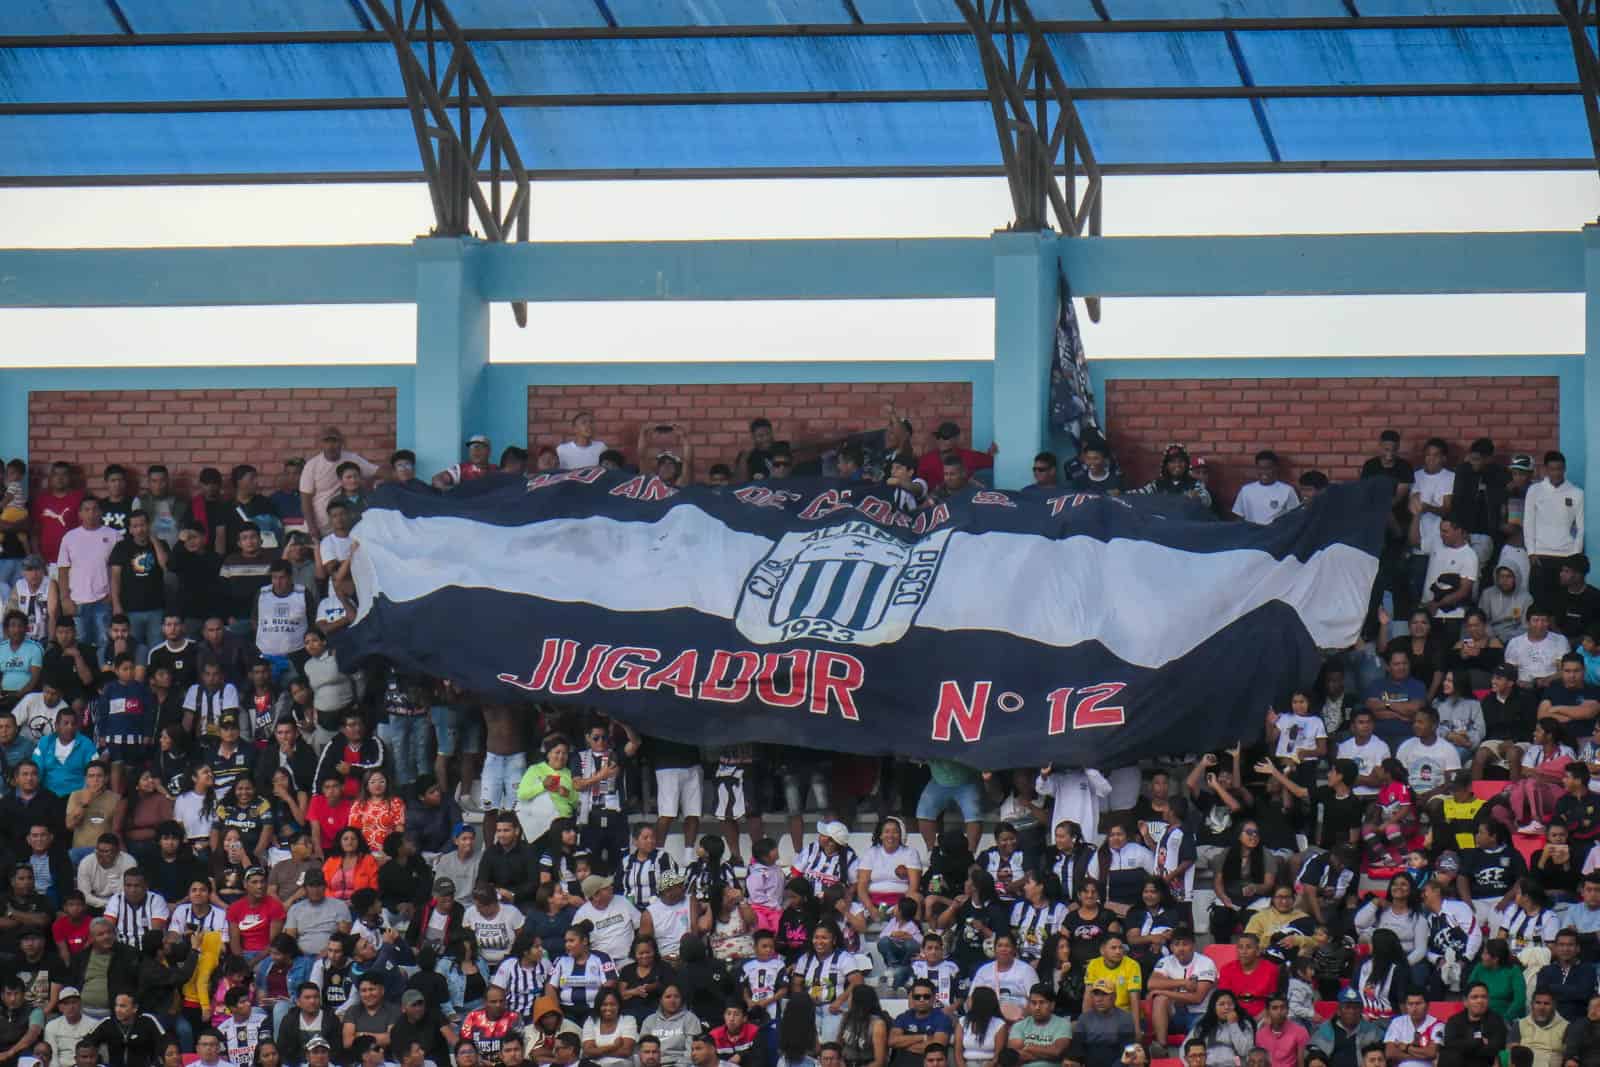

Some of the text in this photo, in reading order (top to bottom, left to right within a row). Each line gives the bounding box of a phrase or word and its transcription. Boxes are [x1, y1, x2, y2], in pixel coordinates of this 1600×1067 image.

[780, 618, 856, 643] 1923
[497, 638, 865, 721] JUGADOR
[1046, 682, 1128, 736] 12
